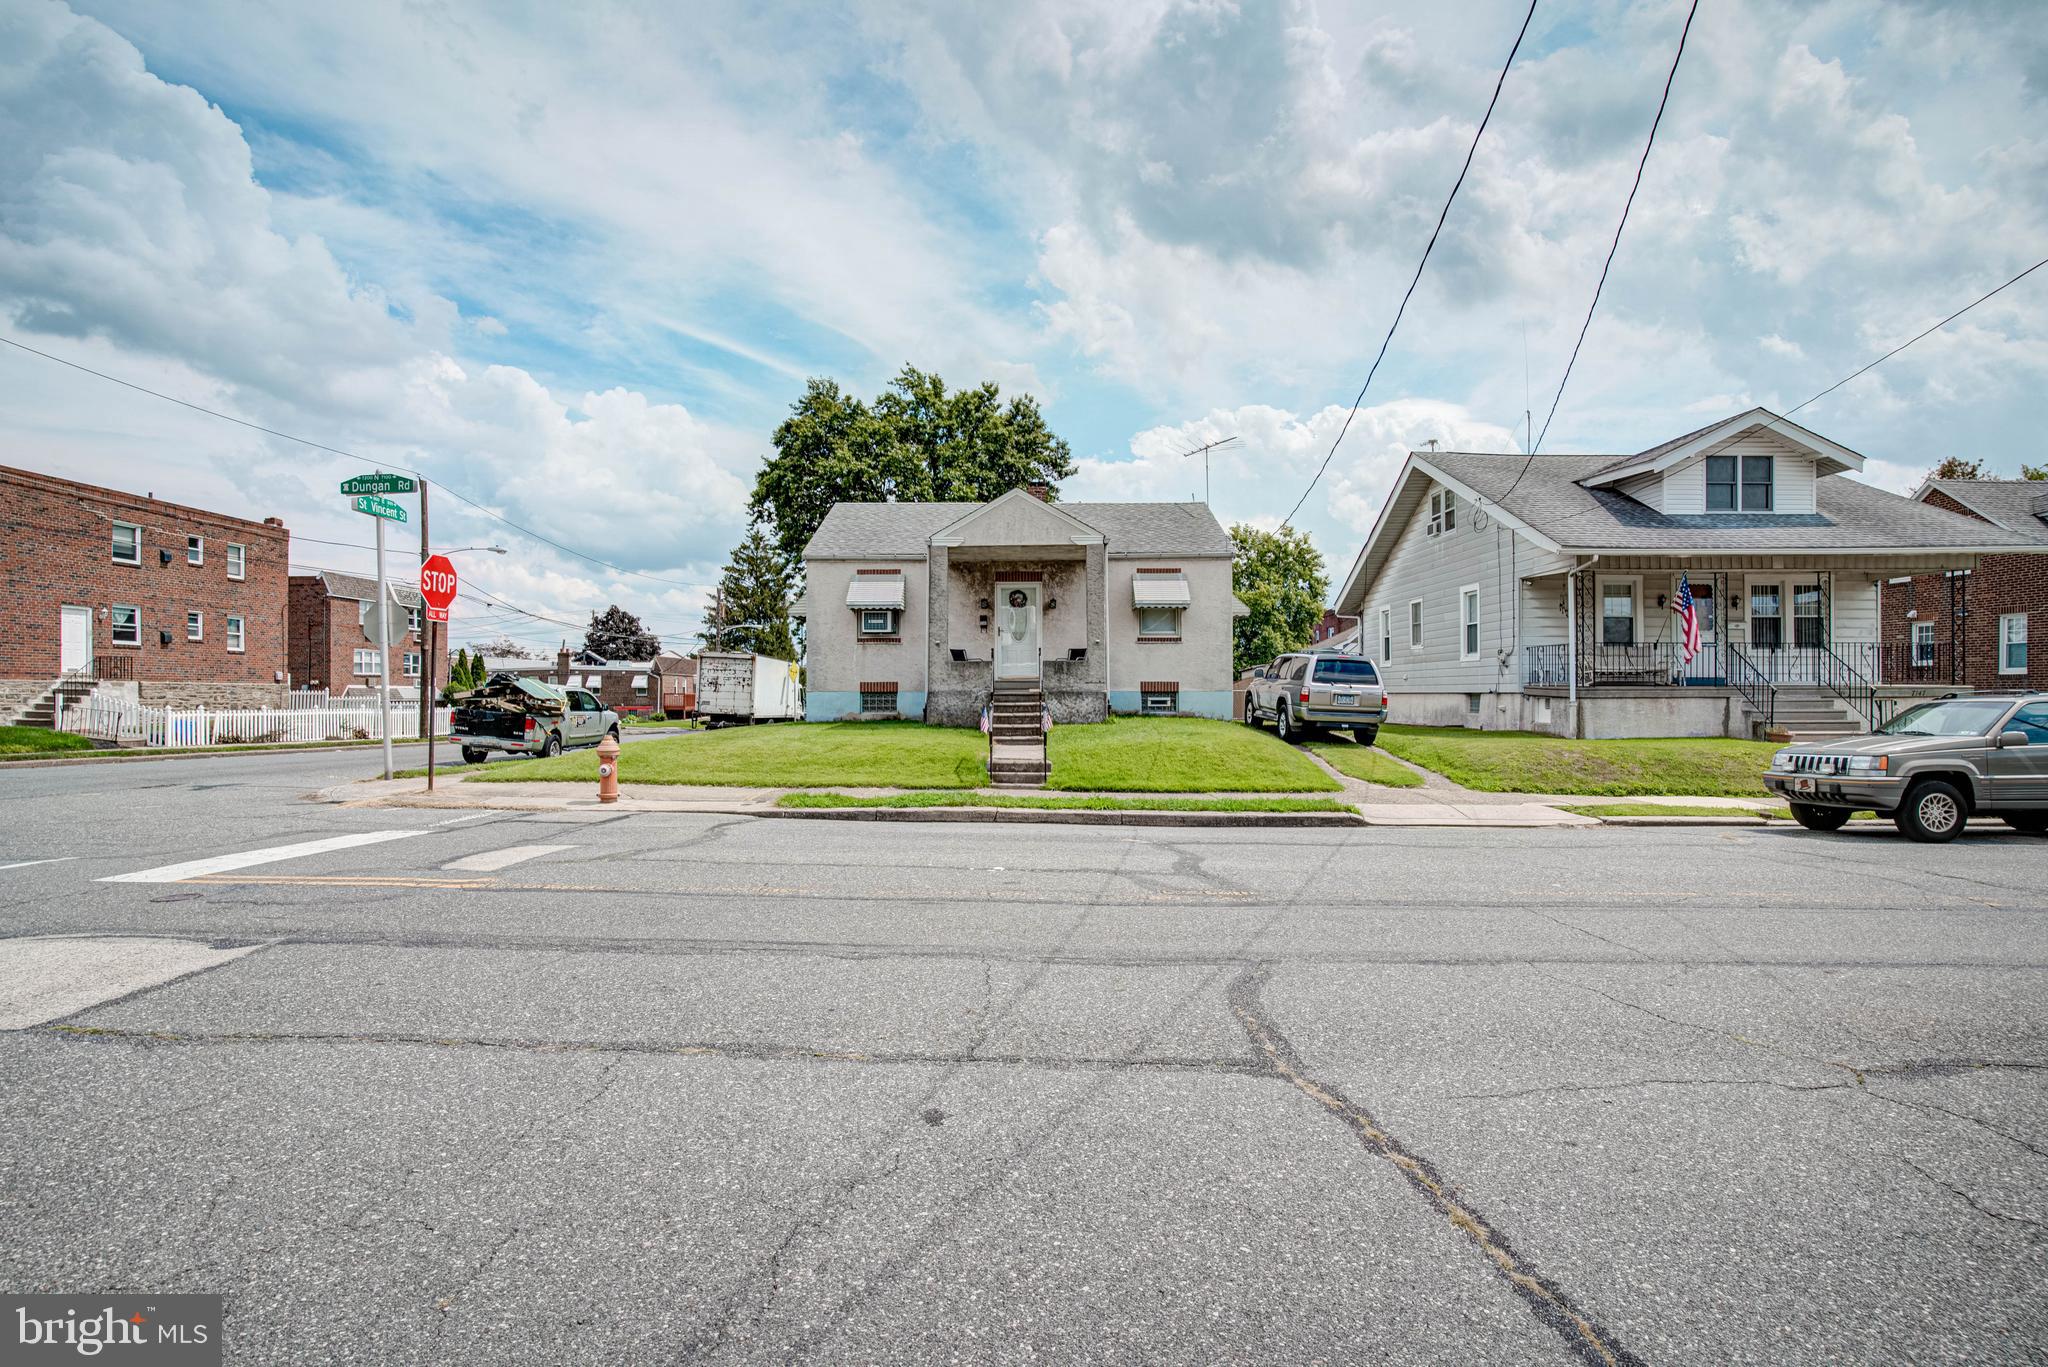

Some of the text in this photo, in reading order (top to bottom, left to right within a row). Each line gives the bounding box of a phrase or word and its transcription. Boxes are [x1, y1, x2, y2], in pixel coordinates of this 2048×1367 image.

[352, 480, 410, 493] Dungan Rd
[358, 497, 367, 510] St
[370, 501, 398, 519] Vincent
[399, 510, 406, 521] St
[423, 570, 456, 594] STOP
